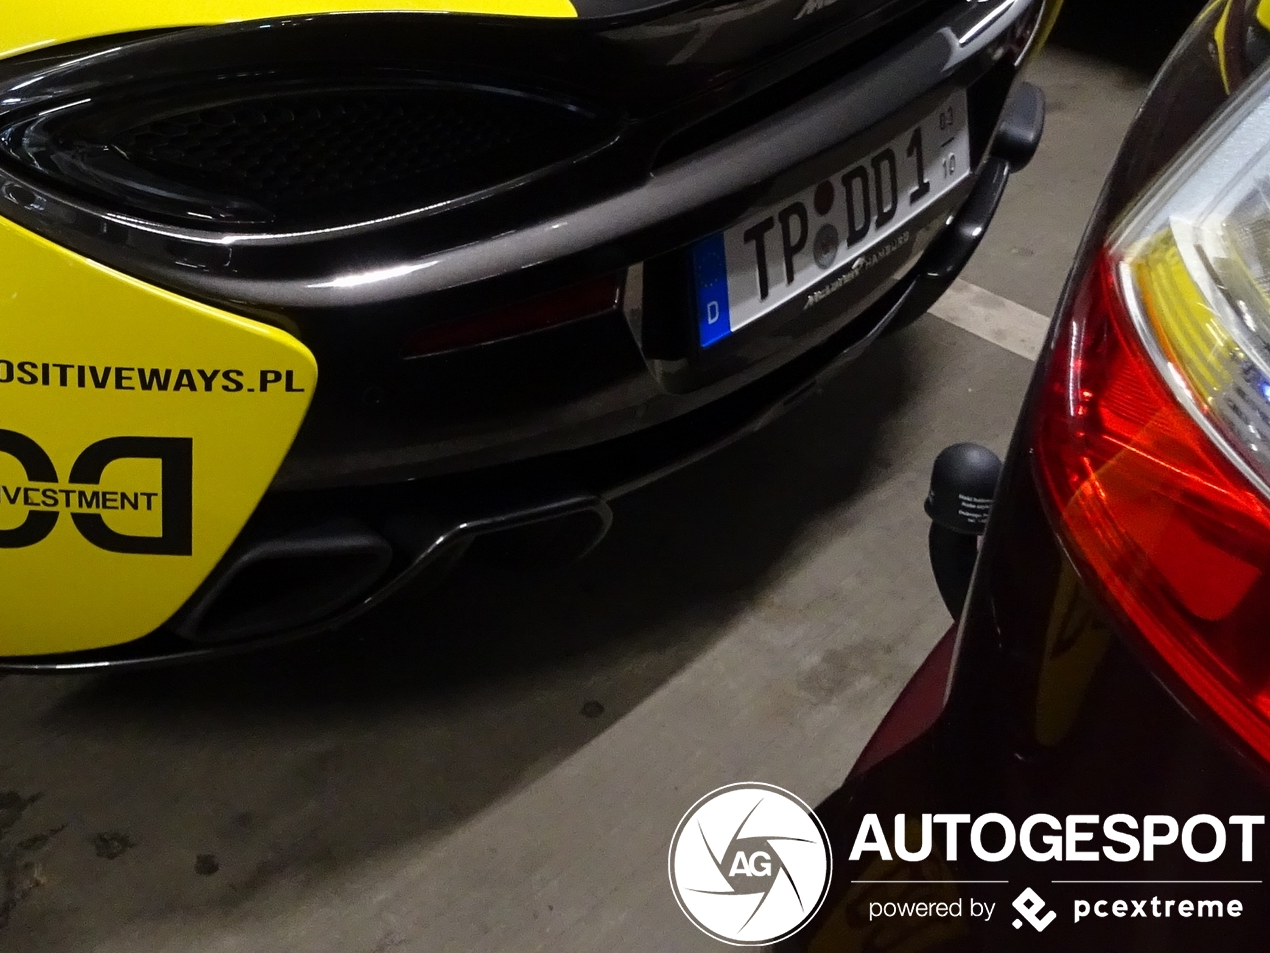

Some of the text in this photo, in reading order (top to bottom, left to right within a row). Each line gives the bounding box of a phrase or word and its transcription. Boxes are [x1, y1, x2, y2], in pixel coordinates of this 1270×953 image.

[744, 126, 931, 303] TP DD 1
[706, 301, 719, 325] D
